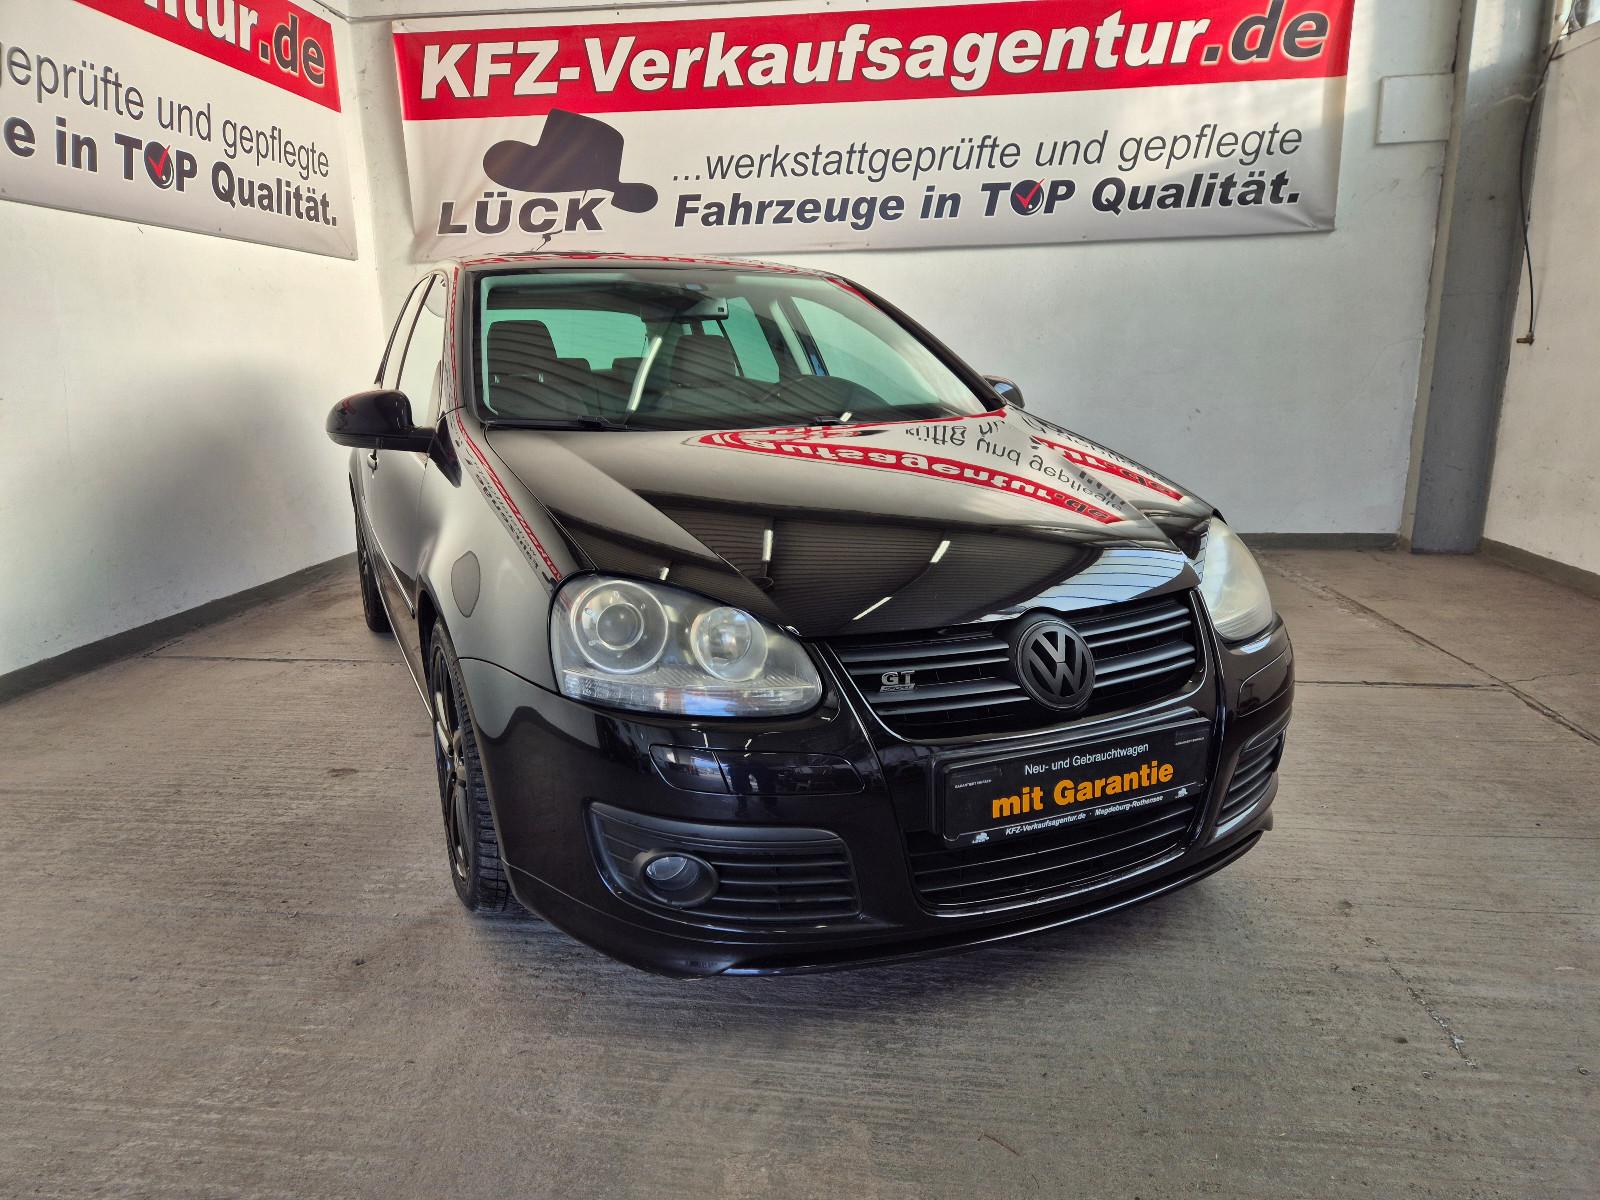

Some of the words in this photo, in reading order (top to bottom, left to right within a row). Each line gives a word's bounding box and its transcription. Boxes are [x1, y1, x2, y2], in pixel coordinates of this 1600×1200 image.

[421, 0, 1328, 100] KFZ-Verkaufsagentur.de
[0, 42, 145, 121] eprüfte
[157, 96, 211, 142] und
[222, 119, 330, 180] gepflegte
[56, 115, 98, 172] in
[115, 132, 198, 192] TOP
[211, 161, 338, 227] Qualität.
[673, 134, 1021, 182] ...werkstattgeprüfte
[1035, 131, 1108, 166] und
[1118, 122, 1302, 171] gepflegte
[438, 191, 606, 235] LÜCK
[675, 193, 904, 230] Fahrzeuge
[920, 185, 961, 219] in
[980, 178, 1076, 216] TOP
[1091, 167, 1301, 216] Qualität.
[881, 671, 915, 686] GT
[1022, 624, 1093, 705] VW
[1025, 764, 1049, 776] Neu-
[1051, 757, 1070, 771] und
[1072, 742, 1149, 767] Gebrauchtwagen
[992, 786, 1044, 819] mit
[1053, 760, 1174, 806] Garantie
[1005, 812, 1087, 836] KFZ-Verkaufsagentur.de
